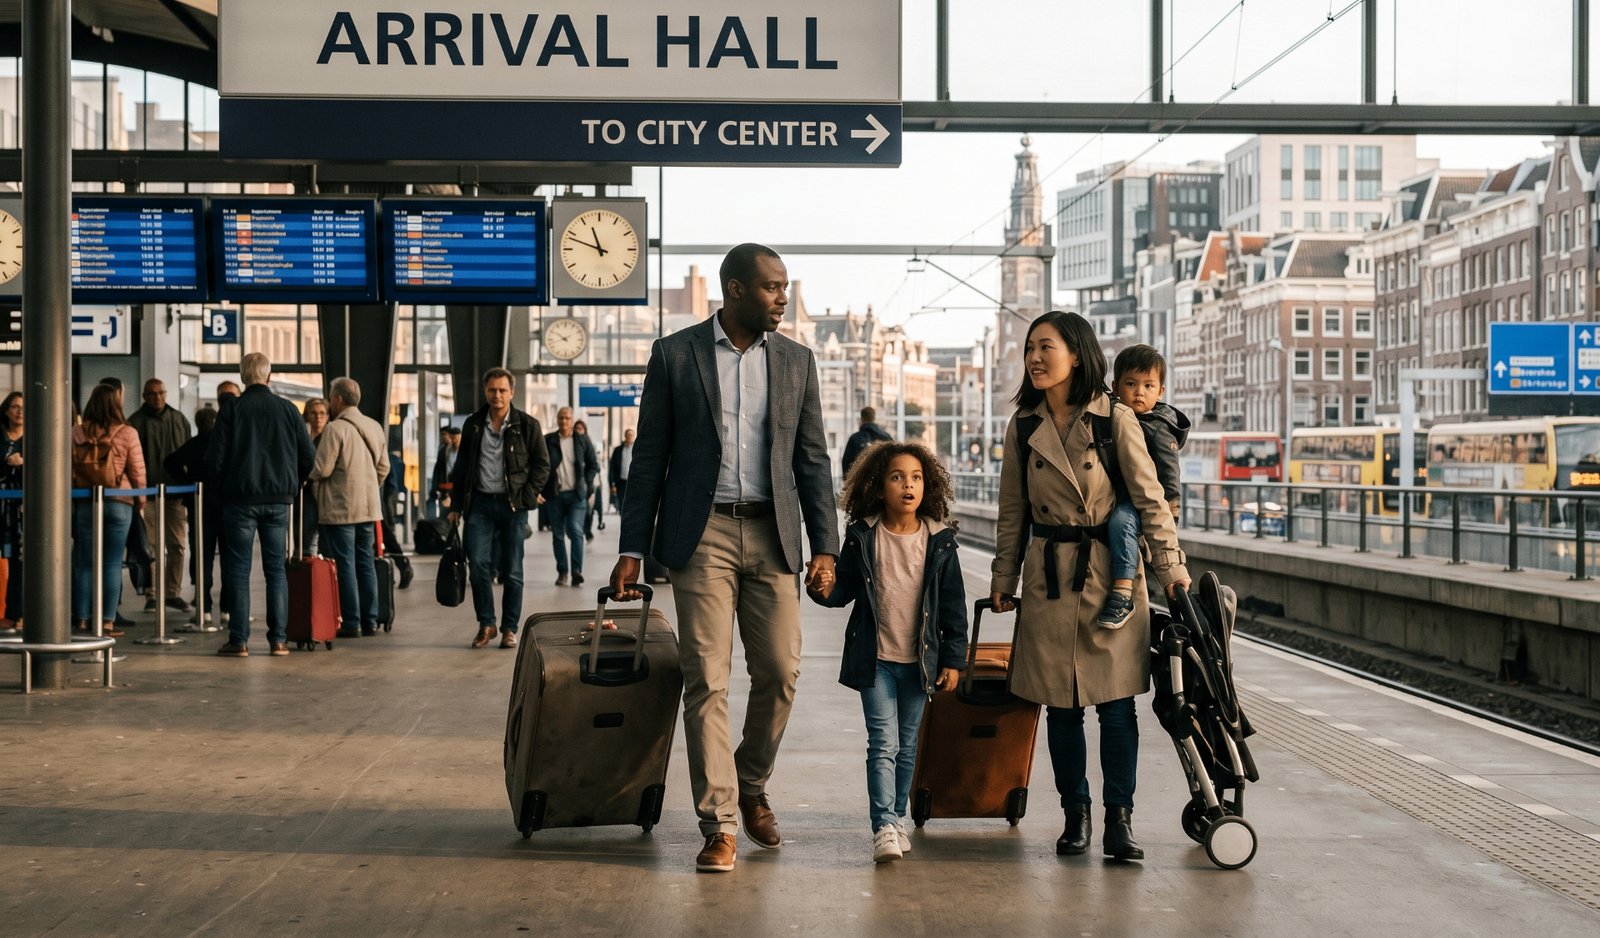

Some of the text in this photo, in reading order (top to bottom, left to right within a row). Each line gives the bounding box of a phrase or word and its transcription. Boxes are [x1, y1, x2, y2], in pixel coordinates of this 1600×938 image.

[315, 11, 838, 70] ARRIVAL HALL
[581, 119, 839, 147] TO CITY CENTER
[212, 314, 228, 337] B
